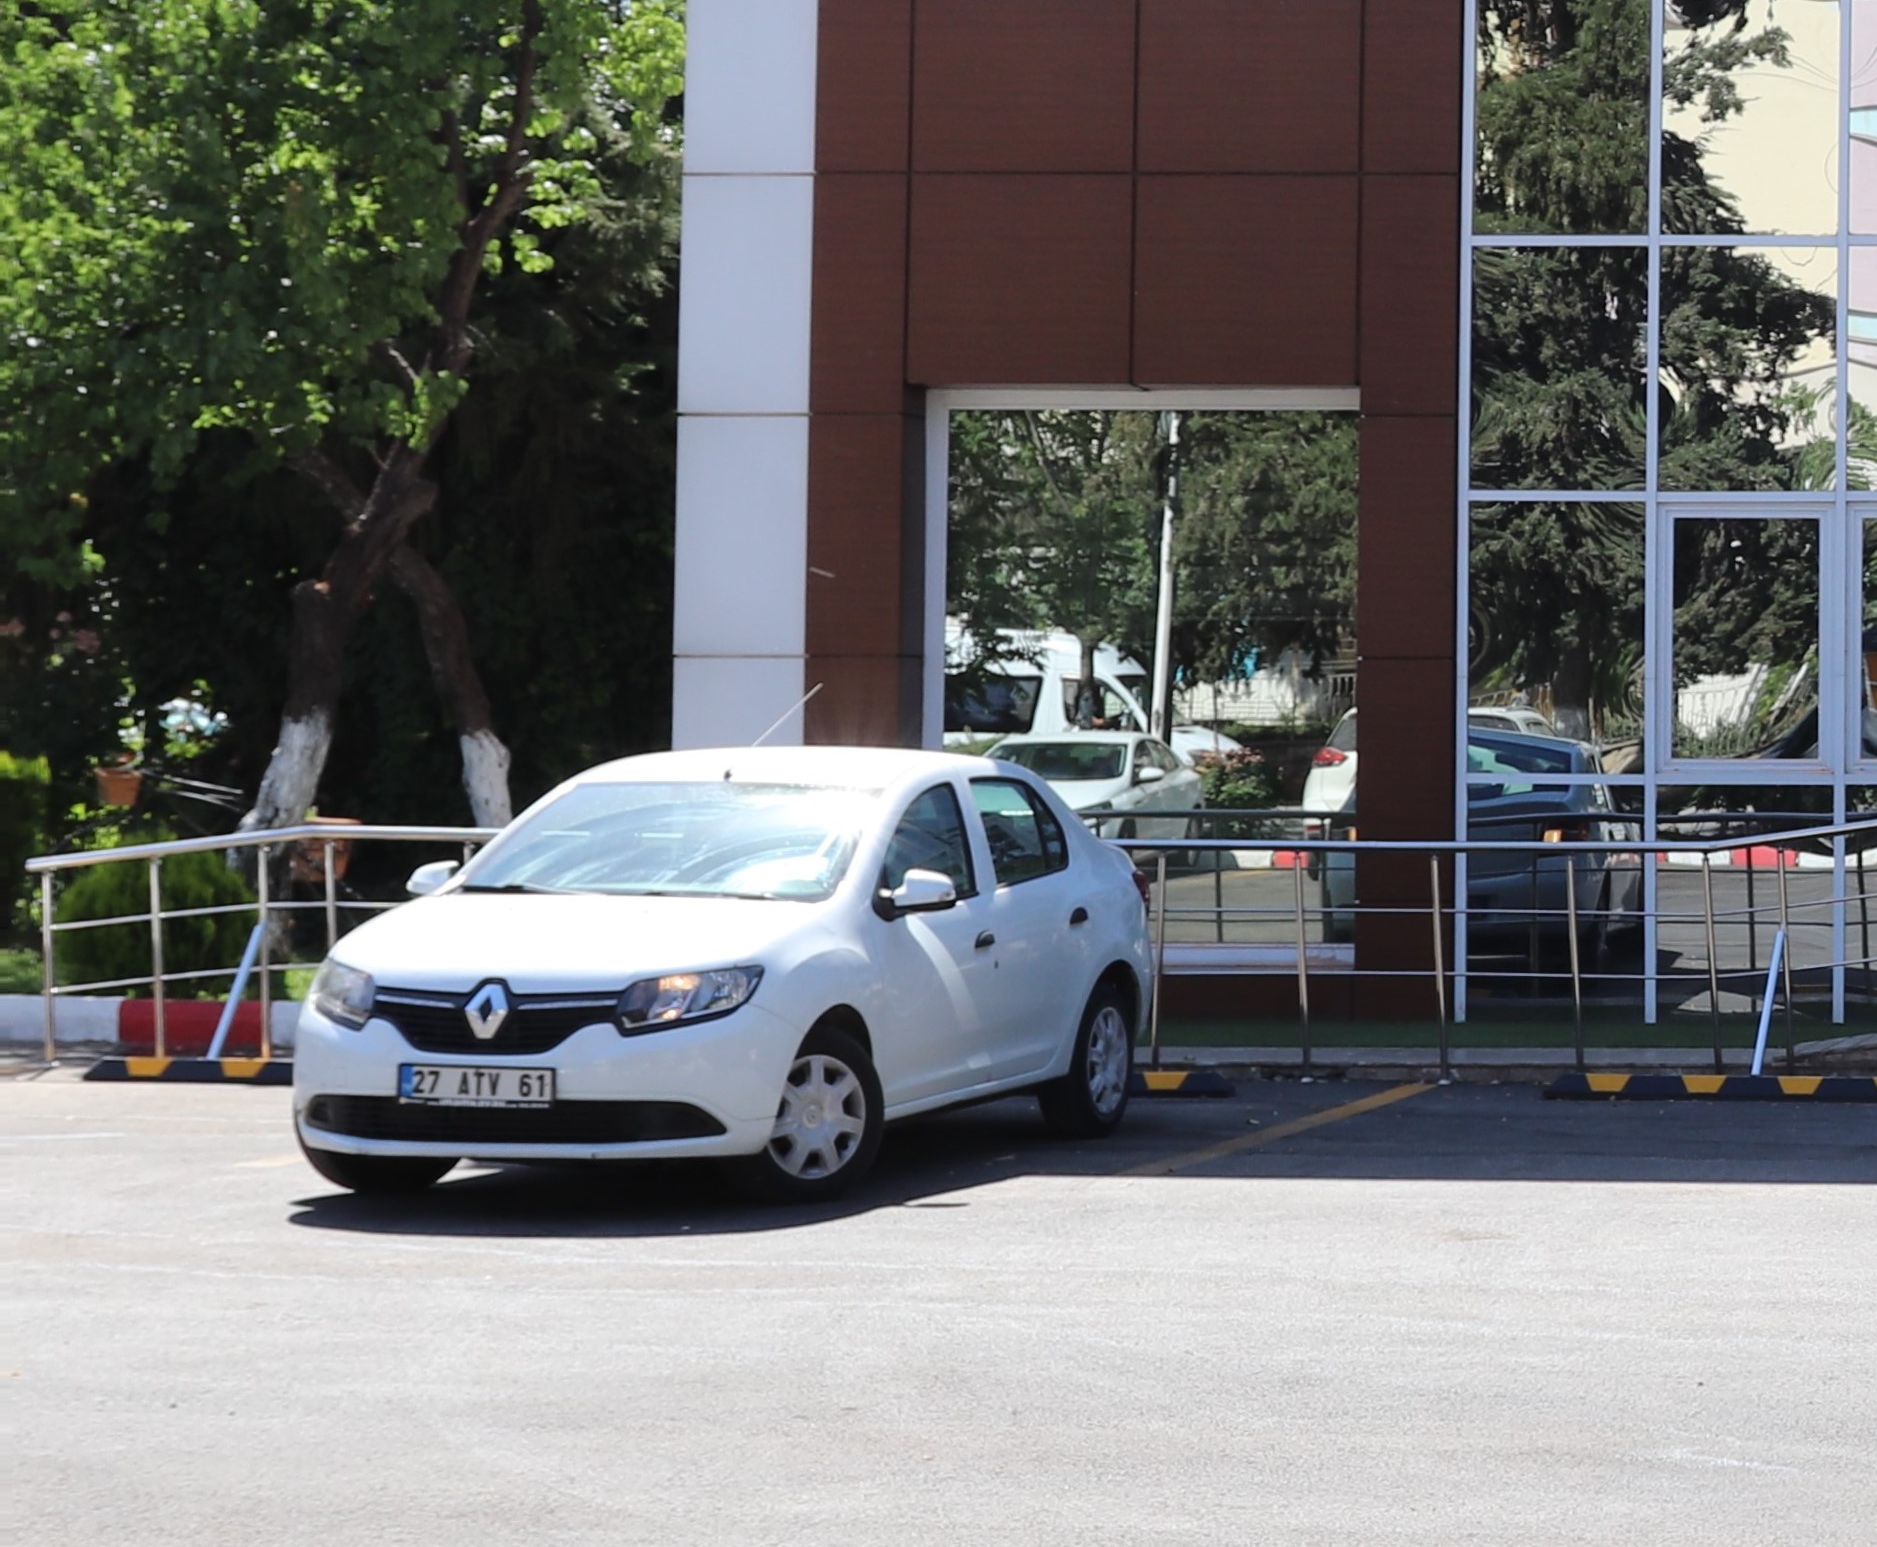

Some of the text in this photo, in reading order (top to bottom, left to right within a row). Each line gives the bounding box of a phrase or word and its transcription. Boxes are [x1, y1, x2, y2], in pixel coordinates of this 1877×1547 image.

[413, 1070, 546, 1098] 27 ATV 61
